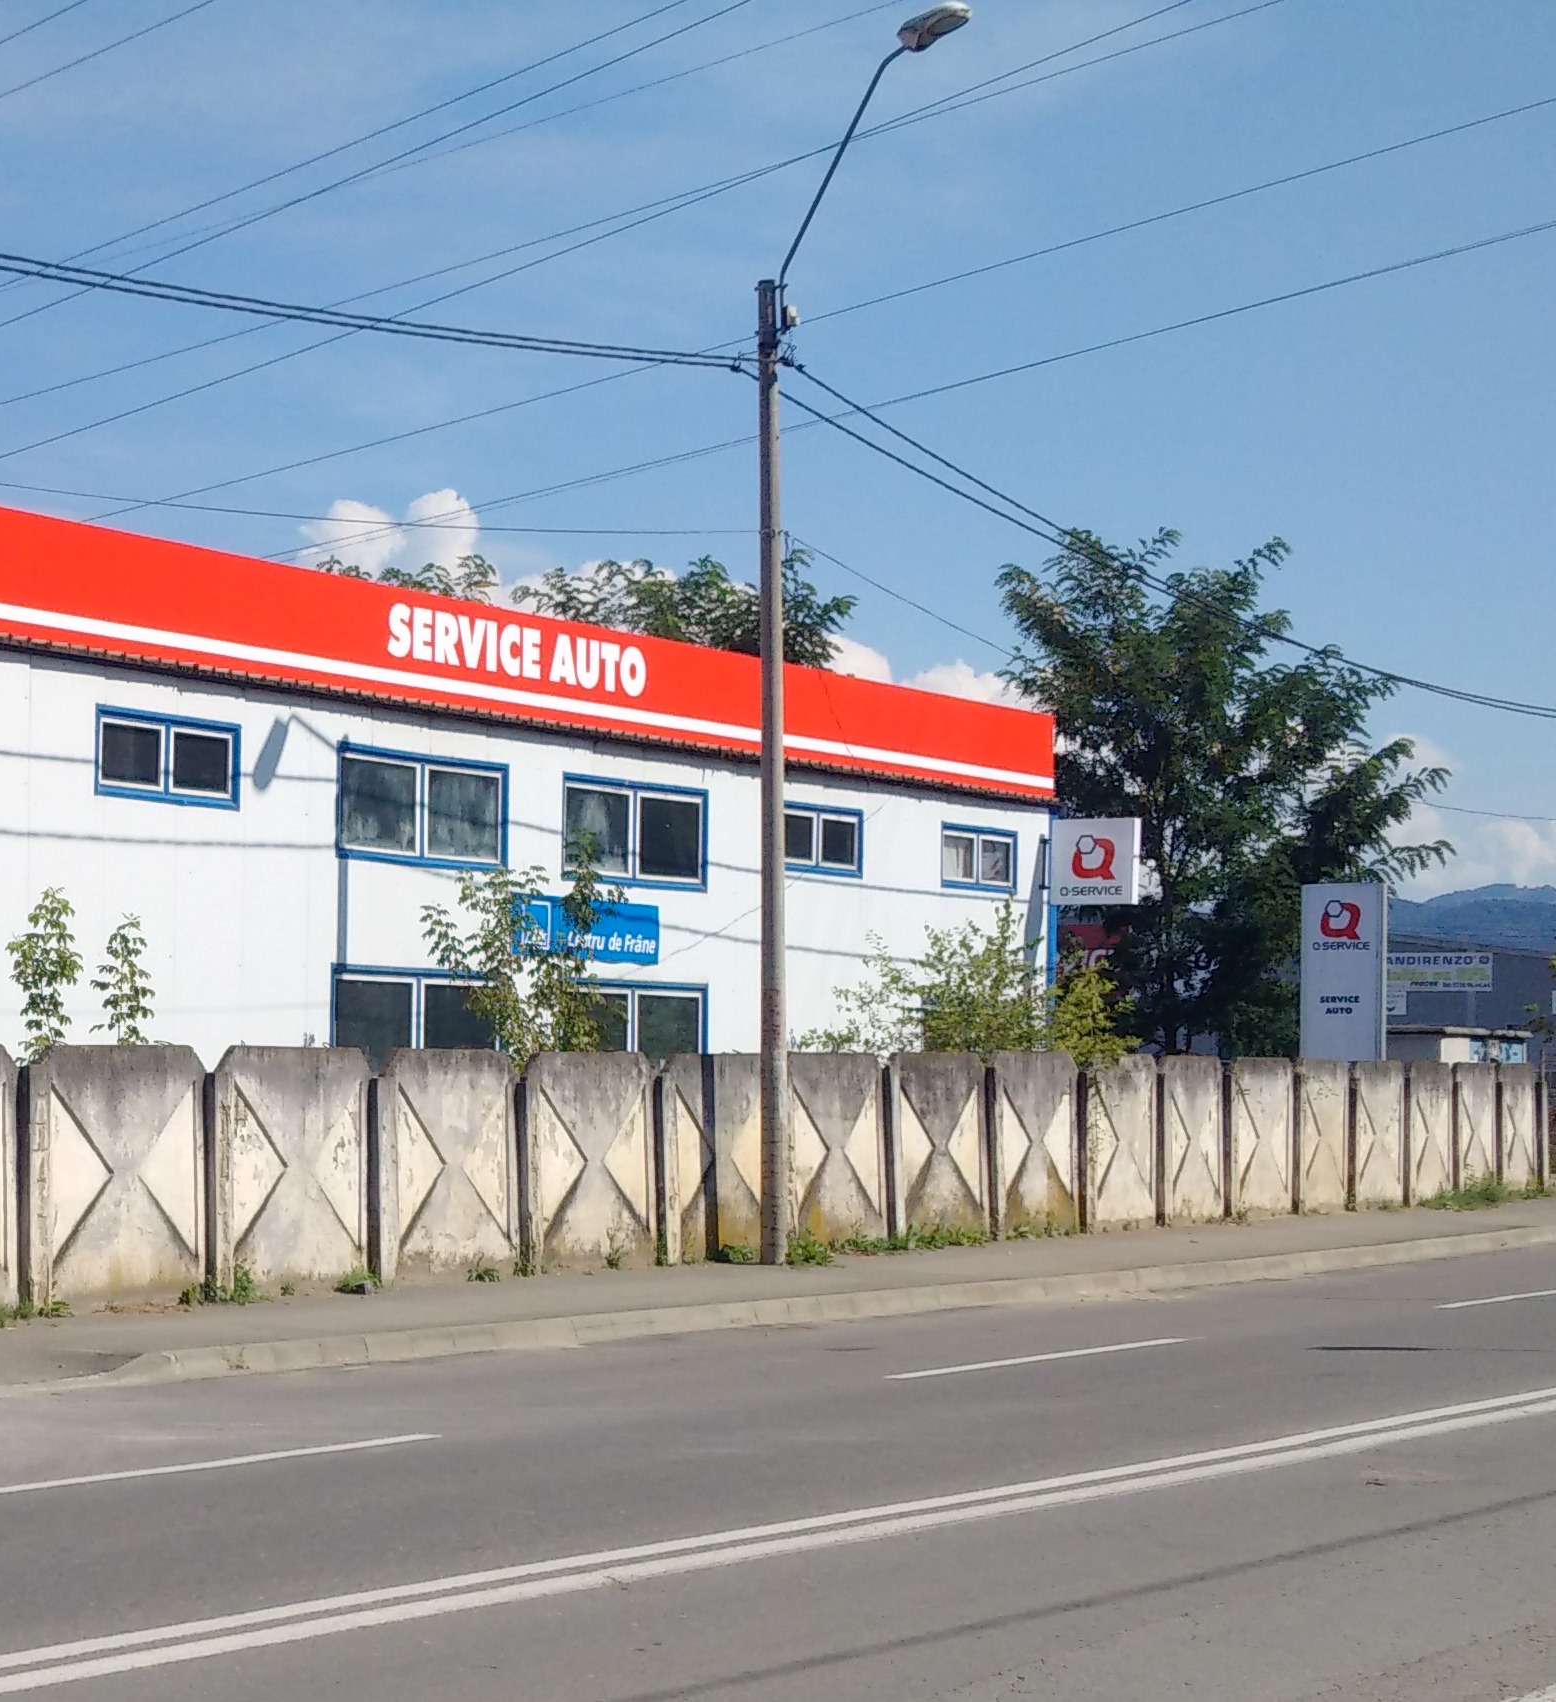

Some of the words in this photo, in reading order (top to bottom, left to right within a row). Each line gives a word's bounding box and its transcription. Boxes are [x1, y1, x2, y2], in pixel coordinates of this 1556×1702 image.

[387, 603, 541, 680] SERVICE
[549, 633, 647, 698] AUTO
[608, 931, 622, 952] de
[624, 933, 656, 955] Frâne
[1319, 995, 1360, 1004] SERVICE
